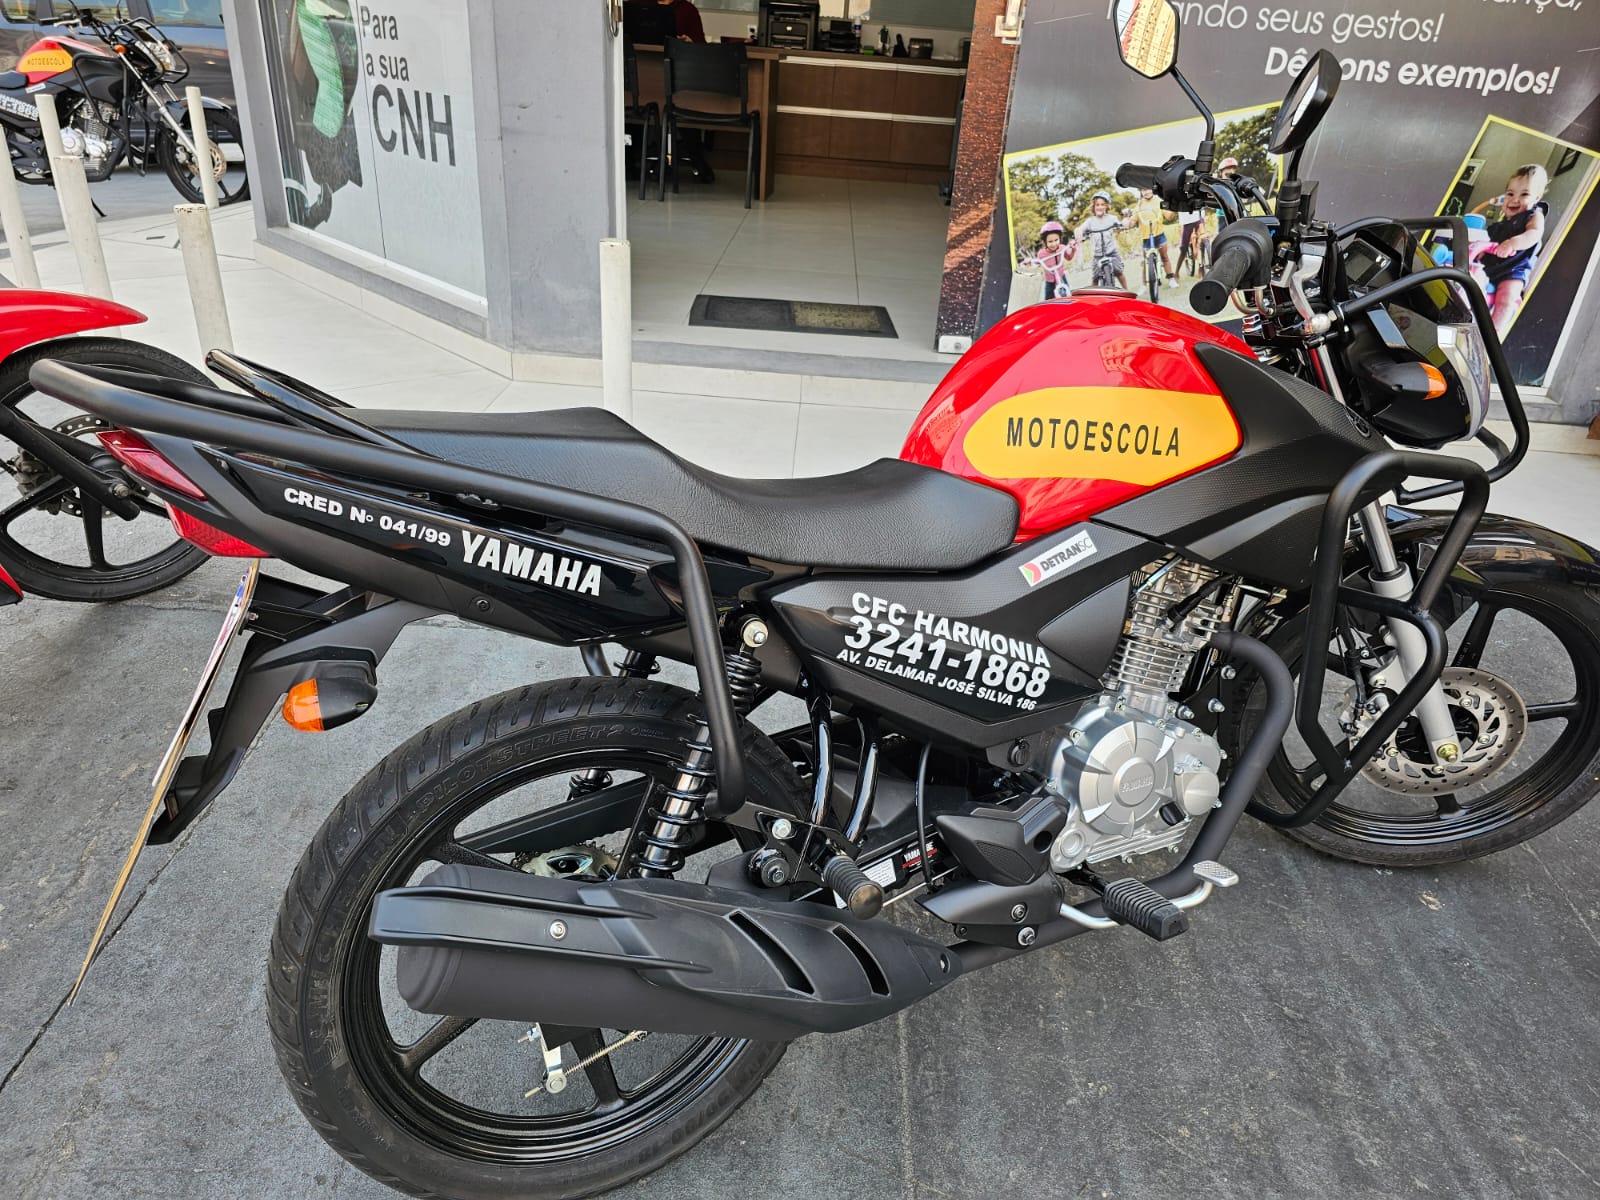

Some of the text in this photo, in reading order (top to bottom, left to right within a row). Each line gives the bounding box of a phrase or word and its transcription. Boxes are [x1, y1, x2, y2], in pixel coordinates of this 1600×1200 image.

[360, 6, 399, 41] Para
[1255, 7, 1325, 34] seus
[1331, 10, 1445, 43] gestos!
[366, 53, 410, 82] a sua
[1264, 46, 1561, 97] Dê ons exemplos!
[372, 83, 456, 167] CNH
[1006, 416, 1180, 457] MOTOESCOLA
[283, 487, 344, 517] CRED
[379, 514, 451, 547] 041/99
[461, 529, 602, 597] YAMAHA
[844, 615, 1051, 699] 3241-1868
[851, 592, 1052, 669] CFC HARMONIA
[836, 649, 1038, 712] AV. DELAMAR JOSÉ SILVA 186
